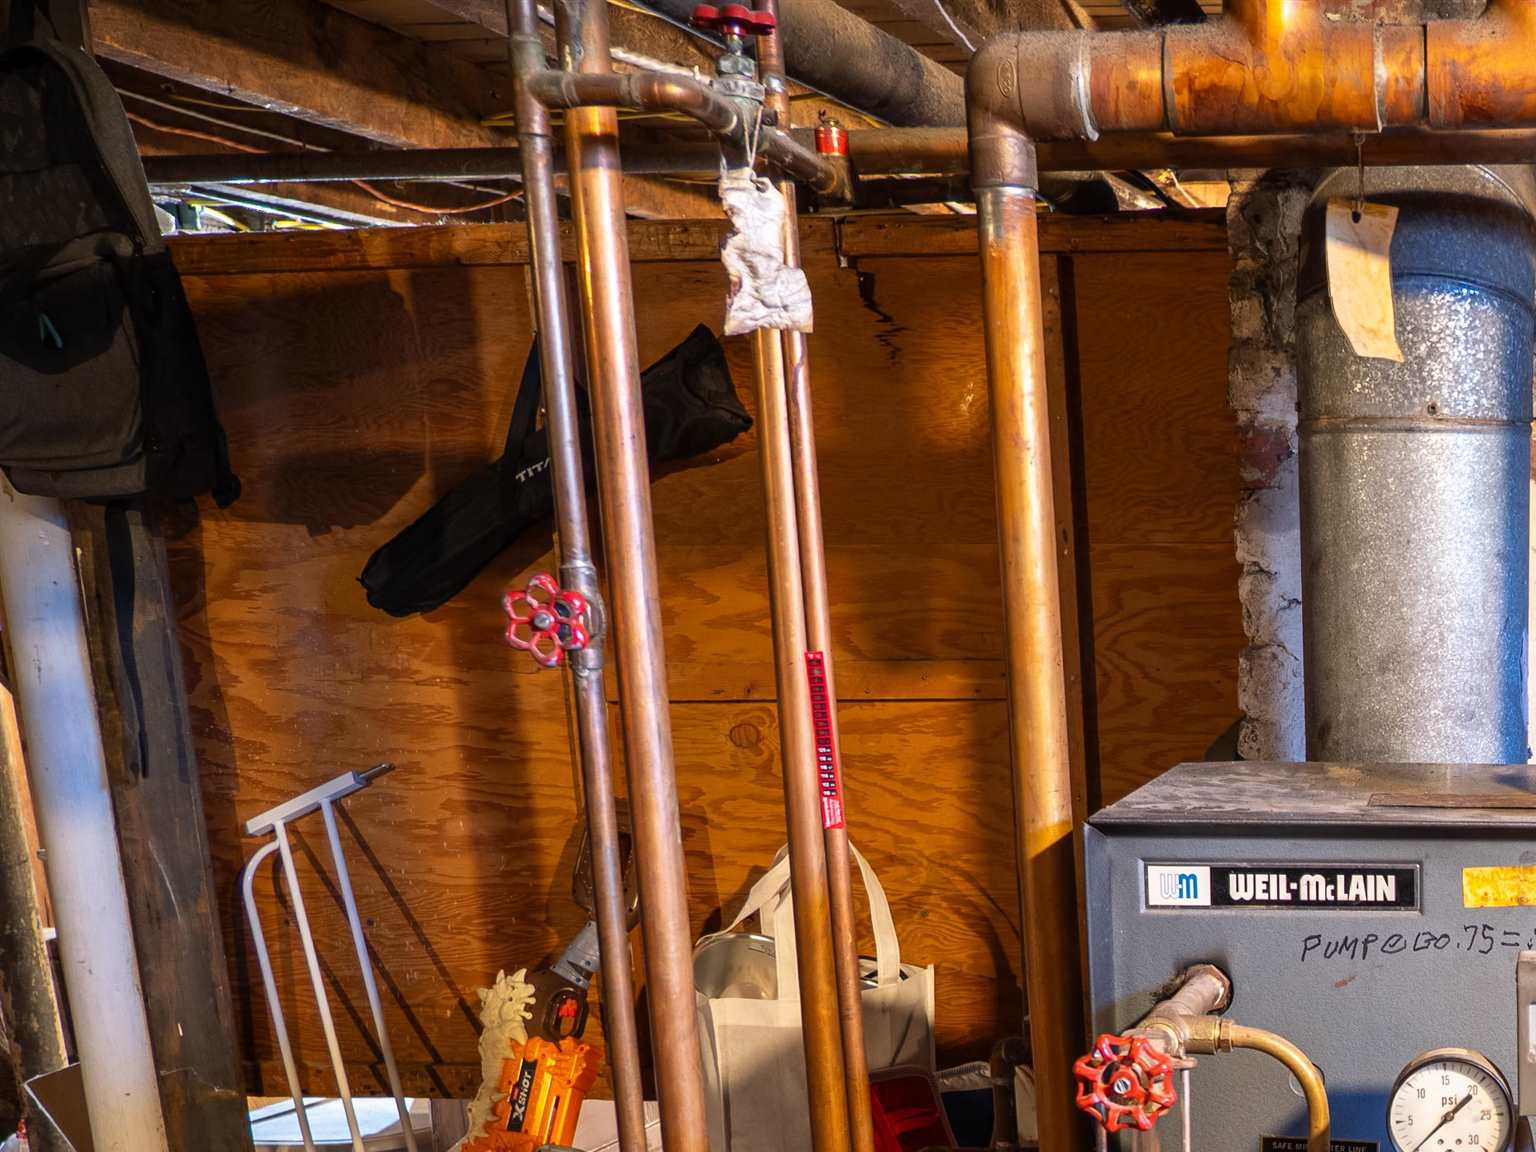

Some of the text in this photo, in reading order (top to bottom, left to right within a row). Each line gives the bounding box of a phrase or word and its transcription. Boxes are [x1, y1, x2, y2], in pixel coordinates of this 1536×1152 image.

[1301, 934, 1378, 961] PUMP
[1441, 1075, 1450, 1086] 15
[1416, 1088, 1426, 1099] 10
[1467, 1085, 1478, 1095] 20
[1441, 1094, 1458, 1107] psi
[1407, 1115, 1413, 1126] 5
[1480, 1110, 1491, 1120] 25
[1468, 1134, 1479, 1145] 30
[1272, 1141, 1293, 1150] SAFE
